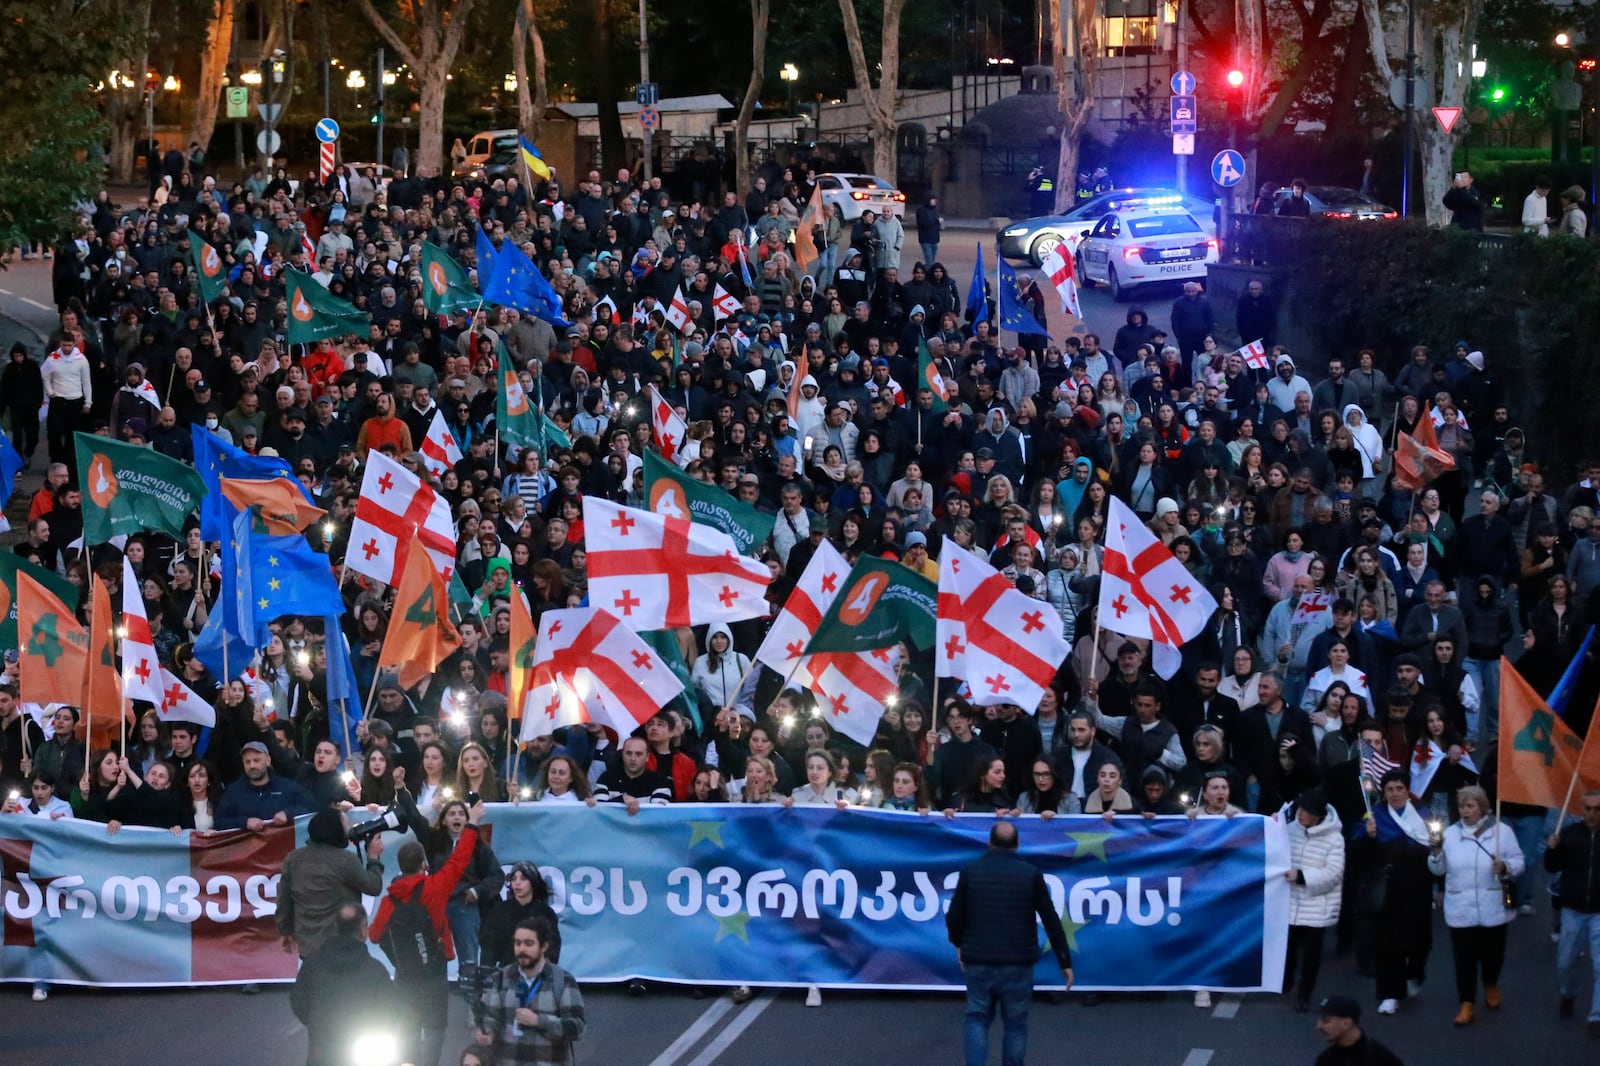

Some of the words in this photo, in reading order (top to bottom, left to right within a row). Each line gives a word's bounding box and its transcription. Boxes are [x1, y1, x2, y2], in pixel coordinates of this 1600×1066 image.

[1160, 264, 1193, 273] POLICE
[115, 468, 191, 503] კოალიცია
[404, 583, 437, 631] 4
[848, 577, 879, 615] 4
[28, 612, 64, 667] 4
[1514, 710, 1554, 767] 4
[414, 931, 429, 966] EPSILON
